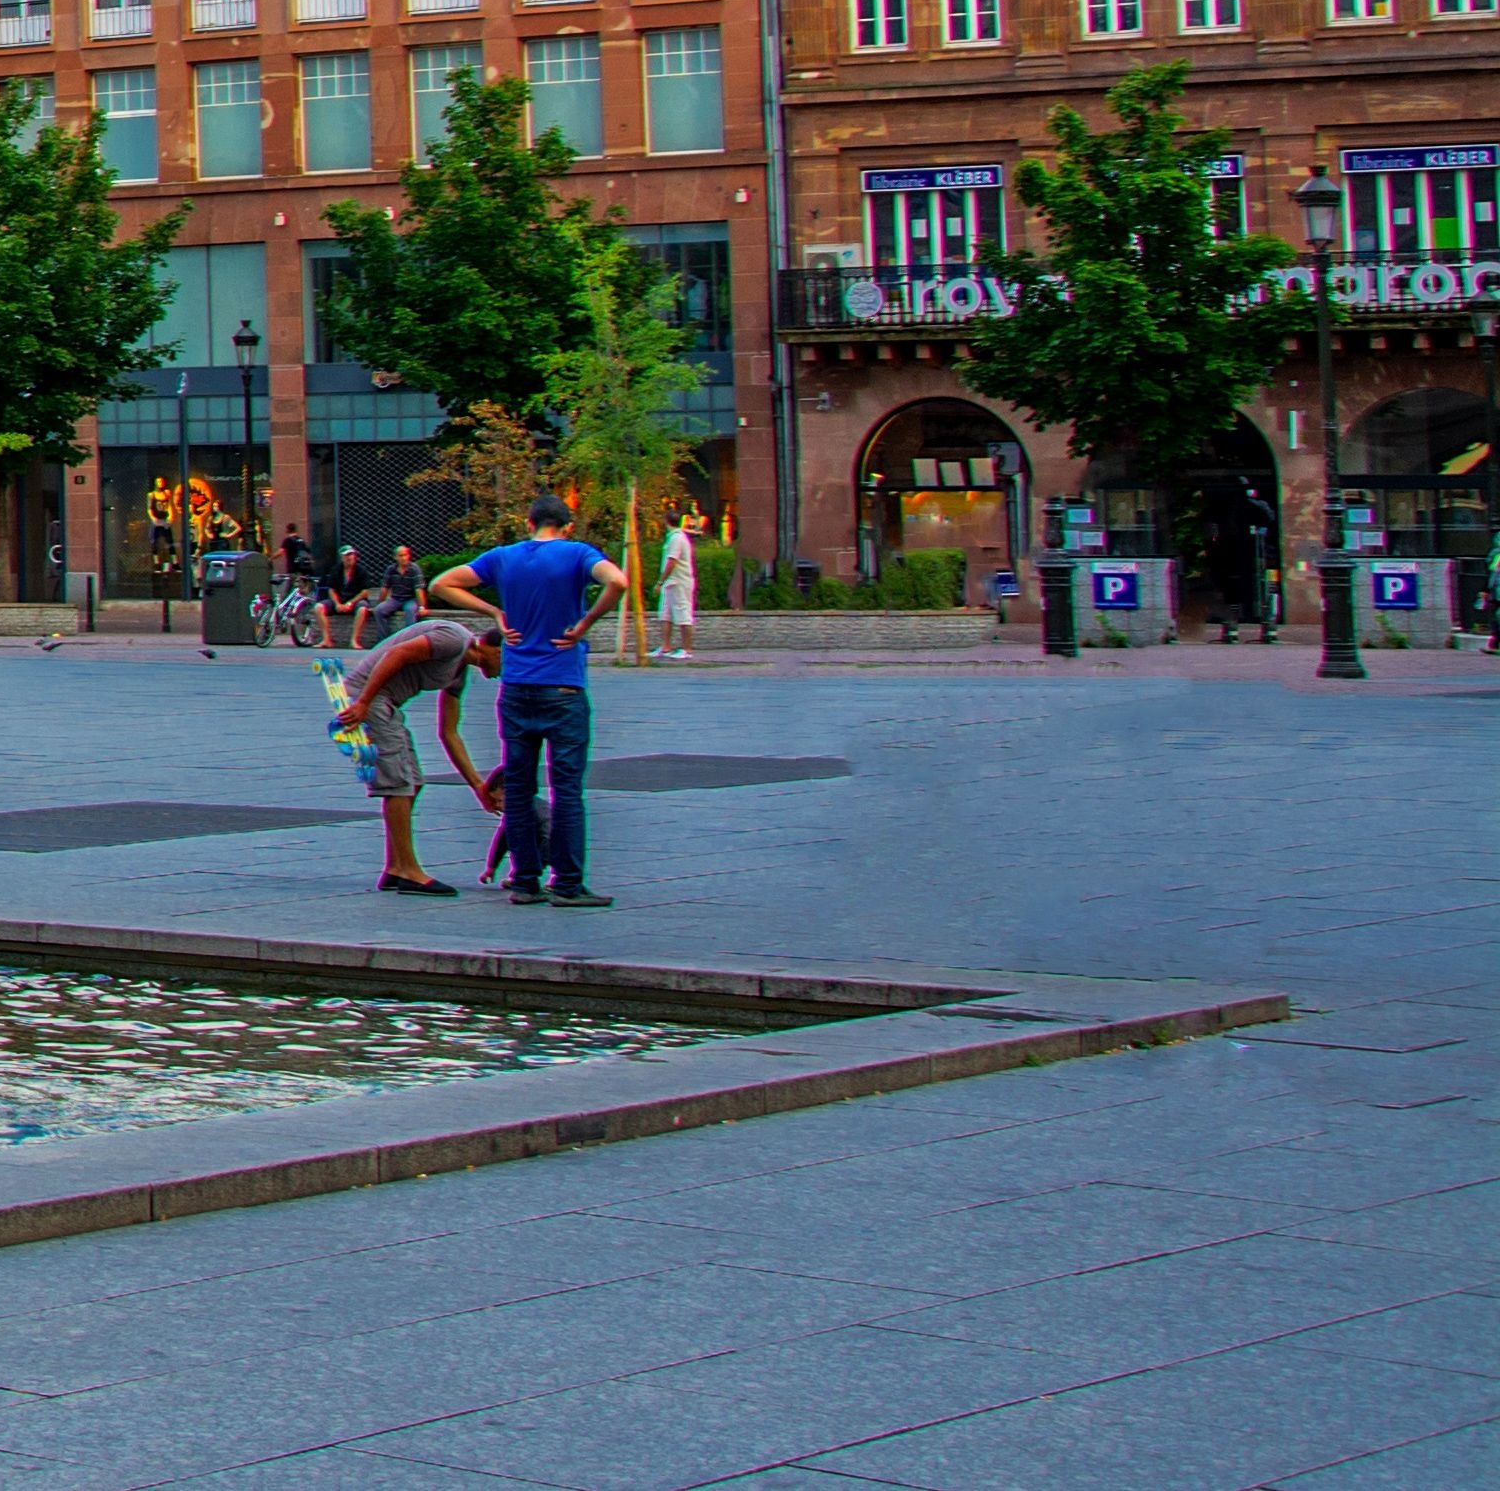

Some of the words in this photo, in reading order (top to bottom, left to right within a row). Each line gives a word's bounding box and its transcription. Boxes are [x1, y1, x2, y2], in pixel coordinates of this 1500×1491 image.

[1424, 149, 1491, 166] KLÉBER
[936, 170, 995, 185] KLÉBER
[1104, 577, 1125, 600] P
[1384, 577, 1404, 600] P
